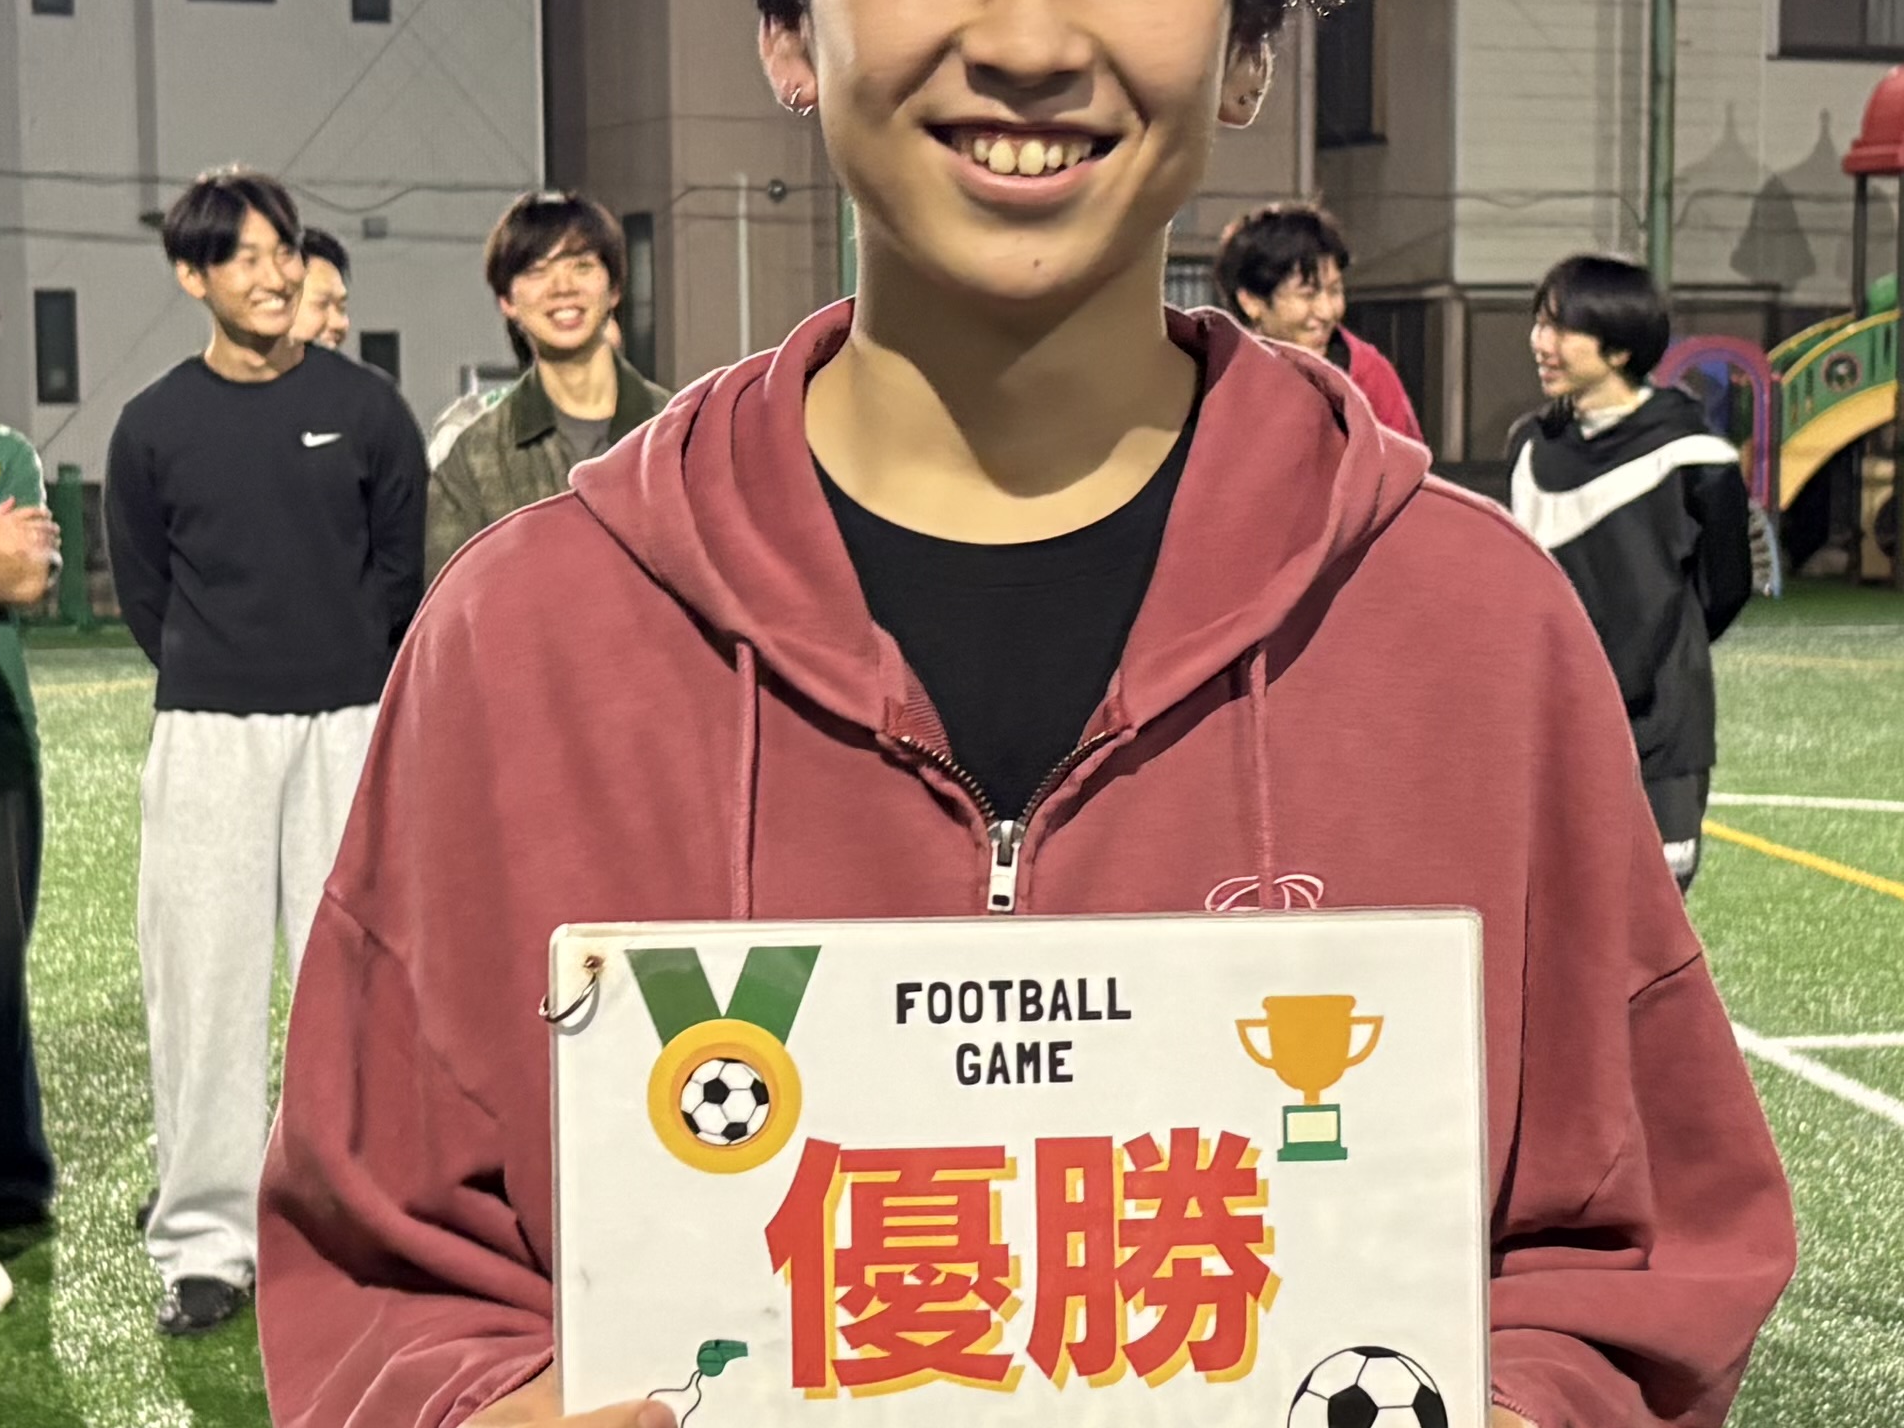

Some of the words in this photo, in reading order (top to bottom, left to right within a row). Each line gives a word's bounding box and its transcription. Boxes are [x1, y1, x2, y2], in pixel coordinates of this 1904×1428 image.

[895, 976, 1132, 1024] FOOTBALL
[955, 1040, 1074, 1086] GAME
[764, 1126, 1283, 1400] 優勝
